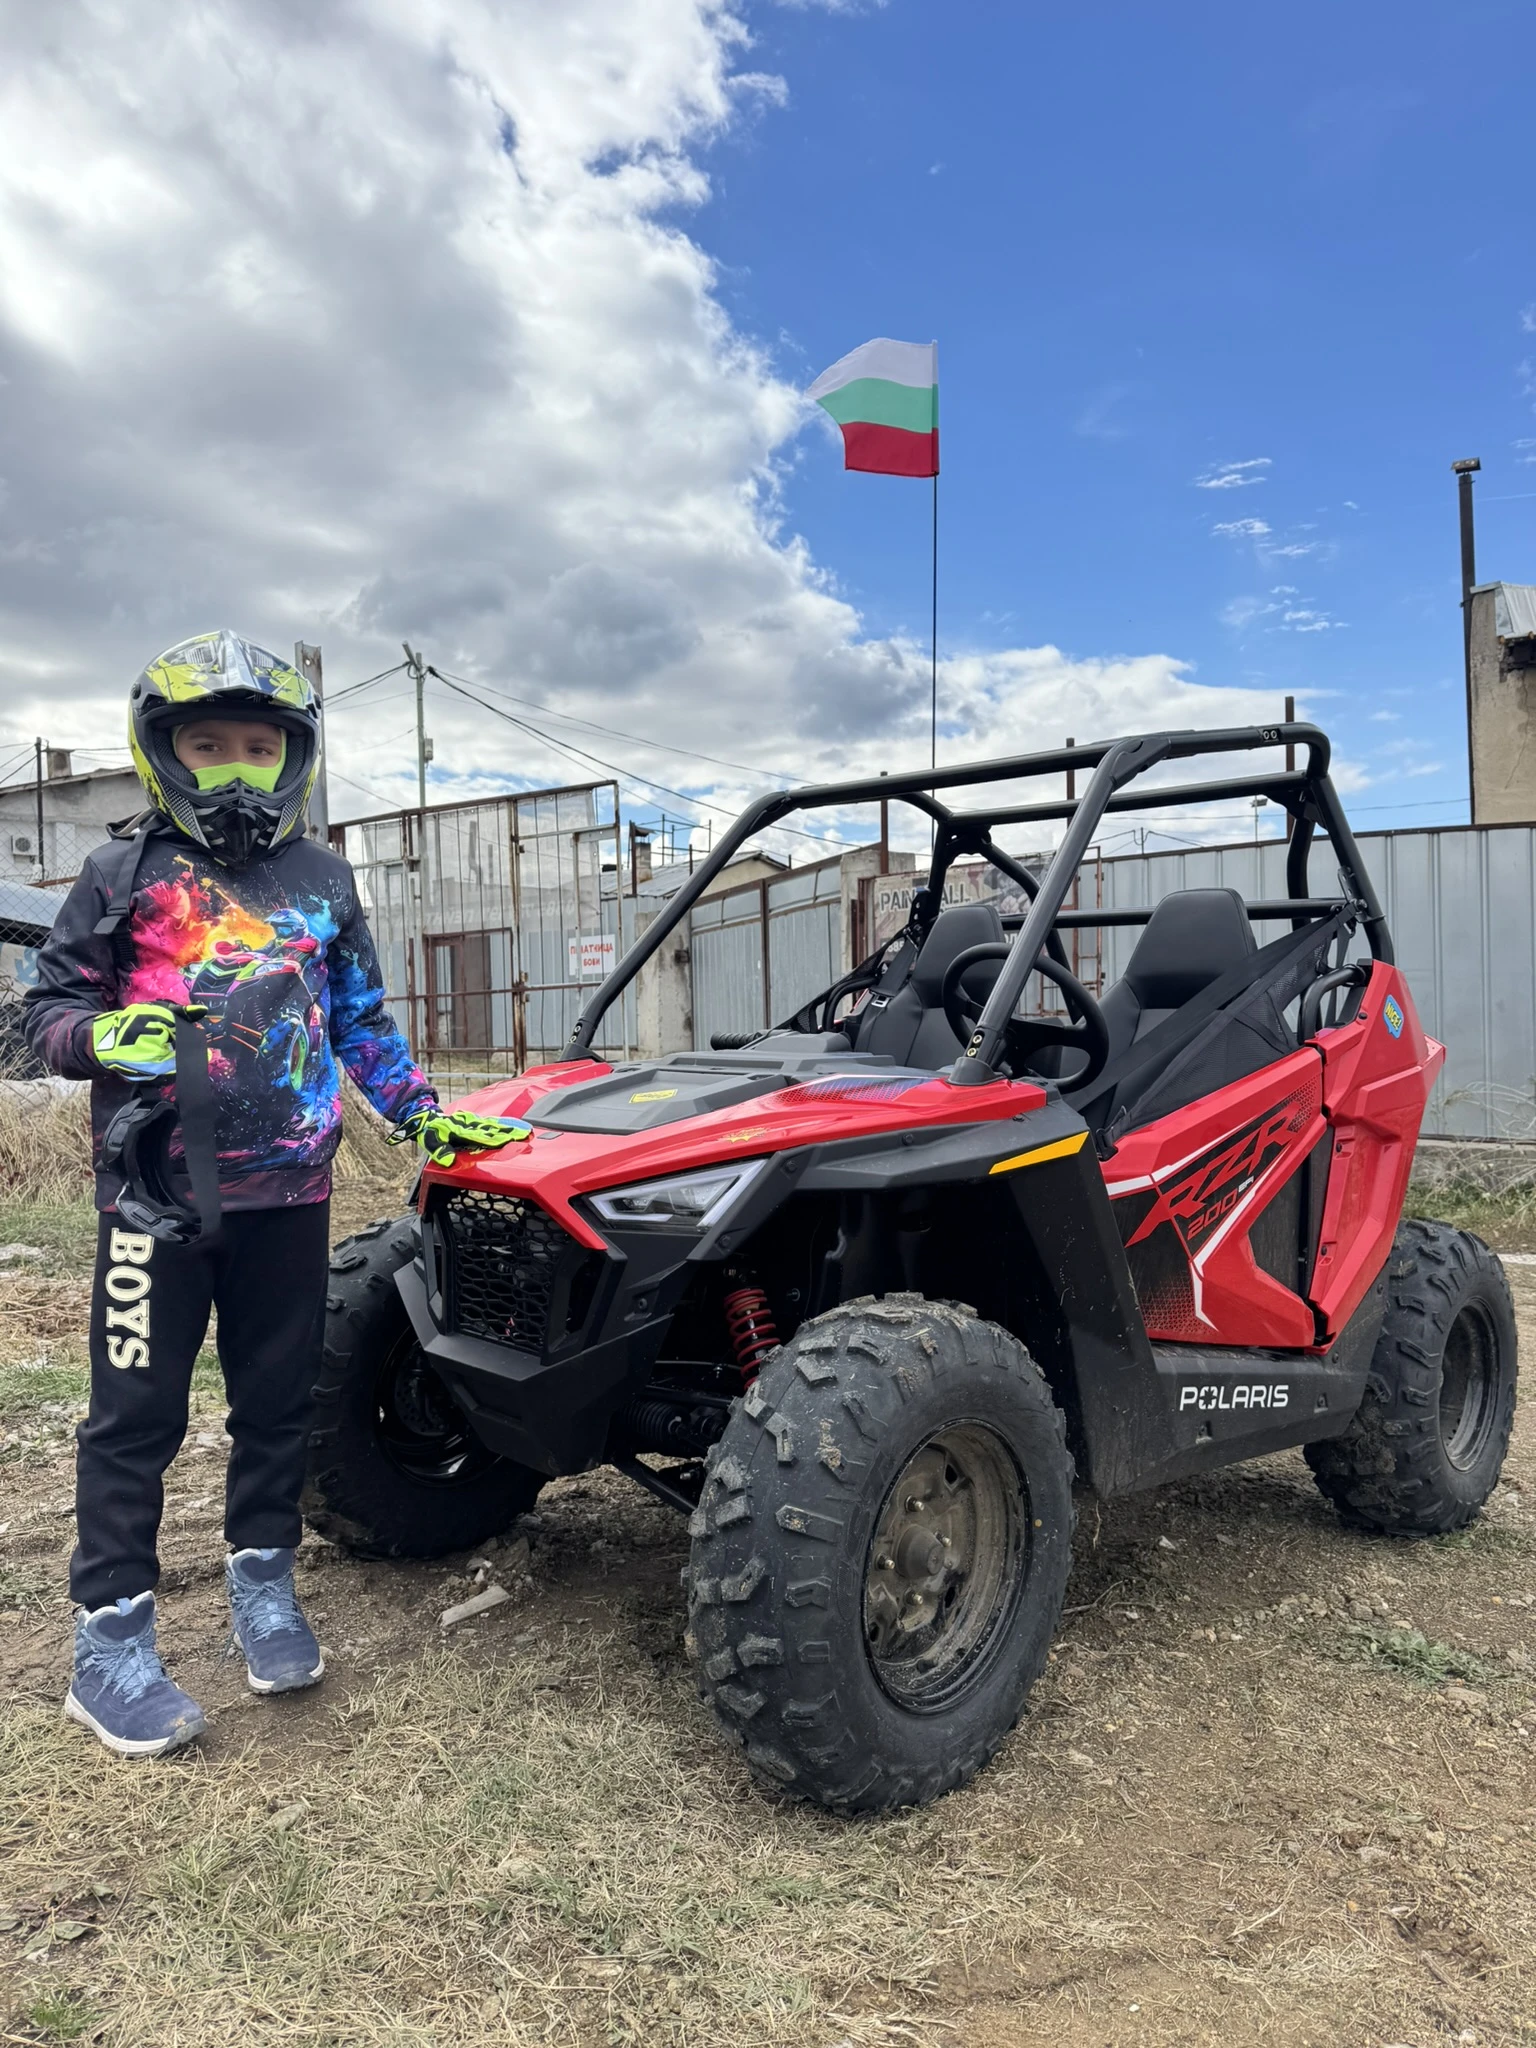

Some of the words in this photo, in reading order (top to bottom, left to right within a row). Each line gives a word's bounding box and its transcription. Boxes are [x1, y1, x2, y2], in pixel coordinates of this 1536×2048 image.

[879, 882, 972, 912] PAINALL
[1125, 1101, 1301, 1248] RZR
[1187, 1188, 1238, 1241] 200
[105, 1227, 155, 1369] BOYS
[1179, 1384, 1289, 1411] POLARIS
